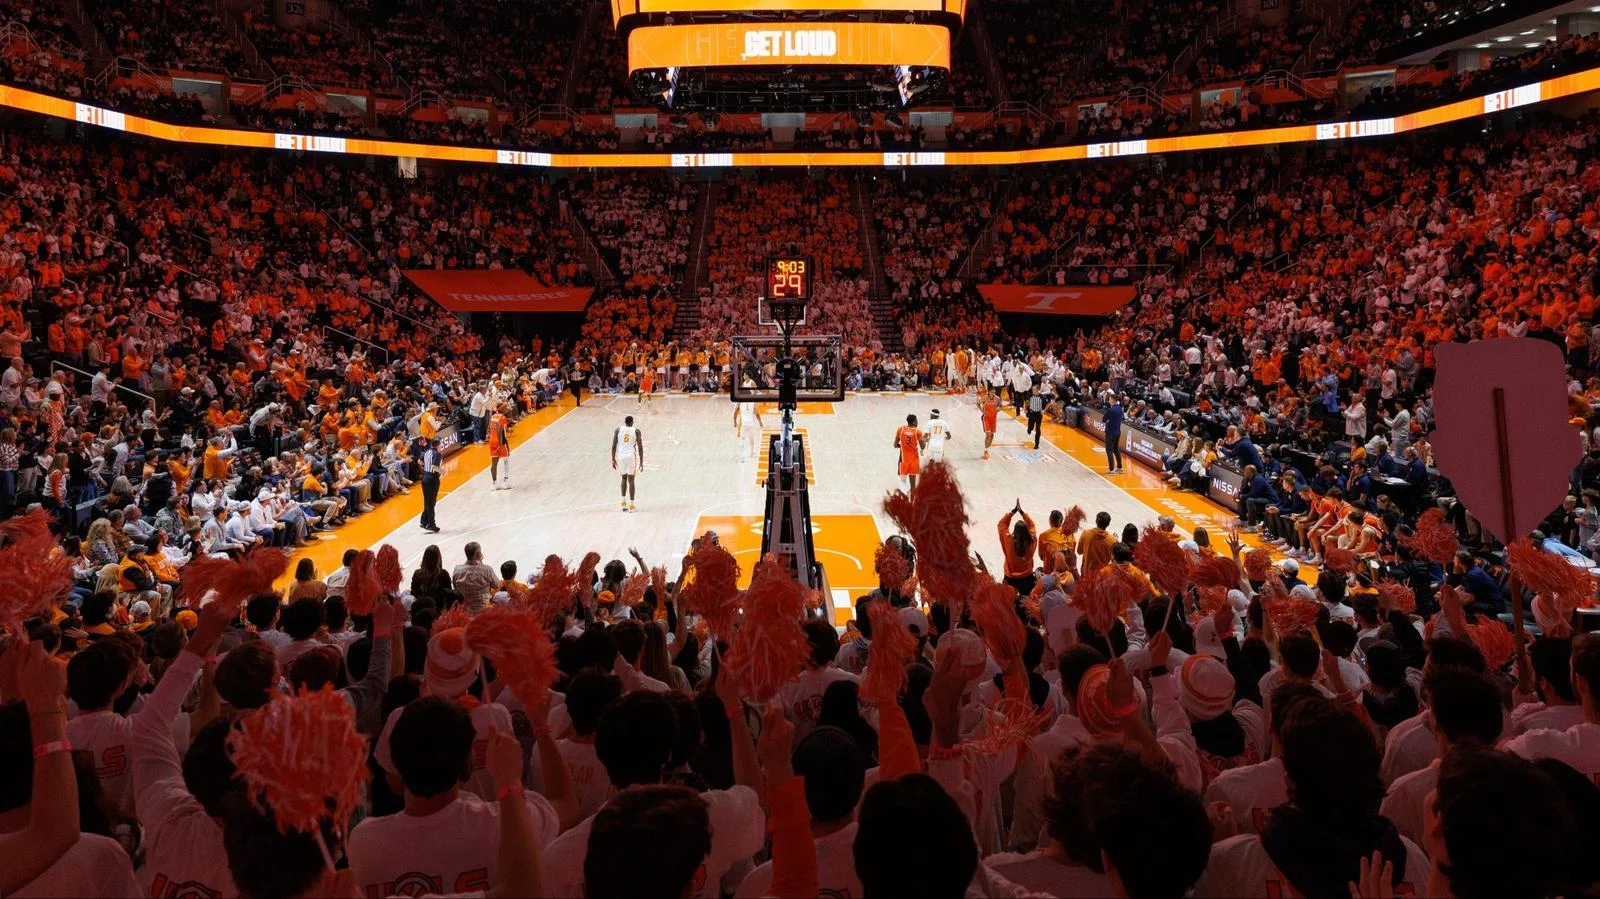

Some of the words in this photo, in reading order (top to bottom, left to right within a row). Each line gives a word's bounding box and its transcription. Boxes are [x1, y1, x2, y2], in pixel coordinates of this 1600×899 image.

[744, 30, 782, 58] GET
[785, 30, 836, 57] LOUD
[777, 261, 805, 274] 9:03
[773, 275, 802, 296] 29
[447, 291, 569, 302] TENNESSEE
[1025, 292, 1082, 310] T
[933, 426, 944, 436] 77
[623, 433, 631, 443] 6
[905, 436, 912, 446] 3
[1212, 477, 1240, 496] NISSA
